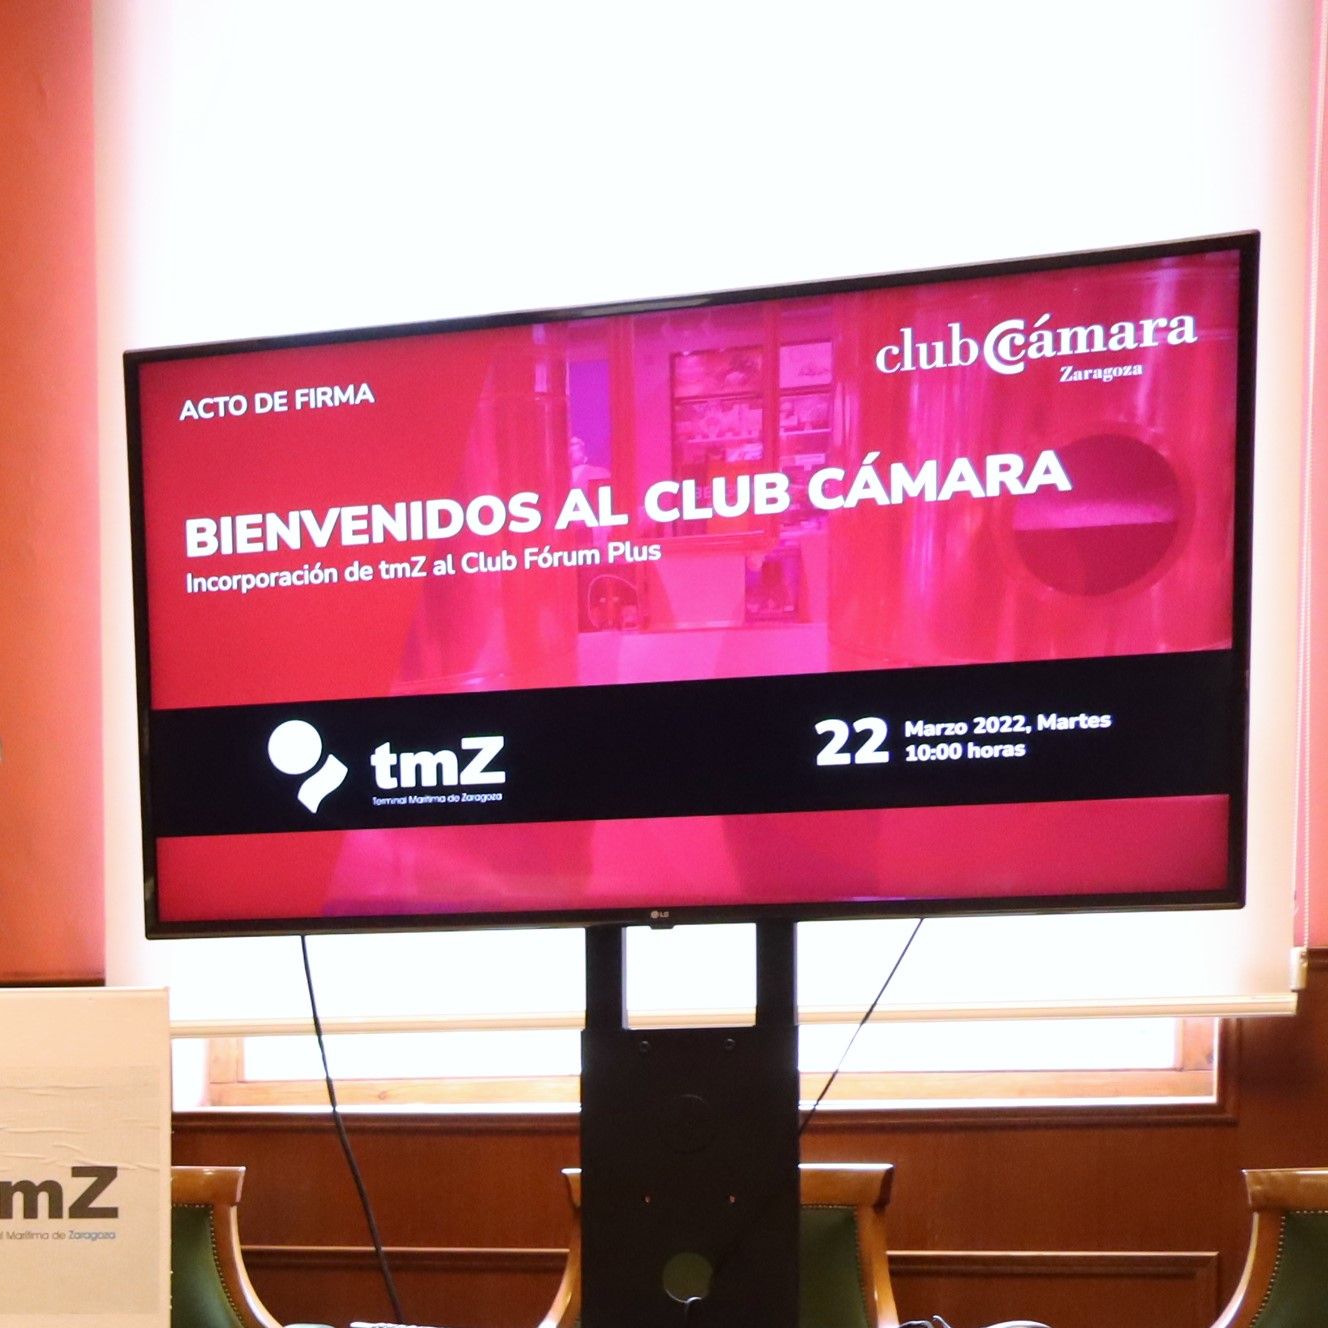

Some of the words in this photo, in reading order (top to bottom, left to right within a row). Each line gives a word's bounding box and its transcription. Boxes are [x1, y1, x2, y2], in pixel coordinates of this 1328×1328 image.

[1059, 362, 1143, 383] Zaragoza
[179, 395, 247, 420] ACTO
[254, 391, 288, 414] DE
[295, 383, 375, 410] FIRMA
[185, 492, 542, 557] BIENVENIDOS
[555, 486, 628, 530] AL
[644, 471, 790, 523] CLUB
[808, 449, 1072, 510] CÁMARA
[186, 562, 338, 593] Incorporación
[344, 559, 373, 582] de
[379, 555, 427, 578] tmZ
[433, 554, 455, 576] al
[463, 550, 517, 575] Club
[524, 545, 601, 570] Fórum
[608, 540, 662, 564] Plus
[814, 717, 890, 766] 22
[905, 720, 968, 738] Marzo
[973, 714, 1032, 734] 2022,
[1037, 713, 1113, 731] Martes
[905, 743, 963, 762] 10:00
[967, 742, 1026, 759] horas
[370, 736, 506, 789] tmZ
[447, 794, 460, 803] de
[461, 793, 502, 804] Zaragoza
[51, 1230, 66, 1241] de
[68, 1230, 116, 1242] Zaragoza
